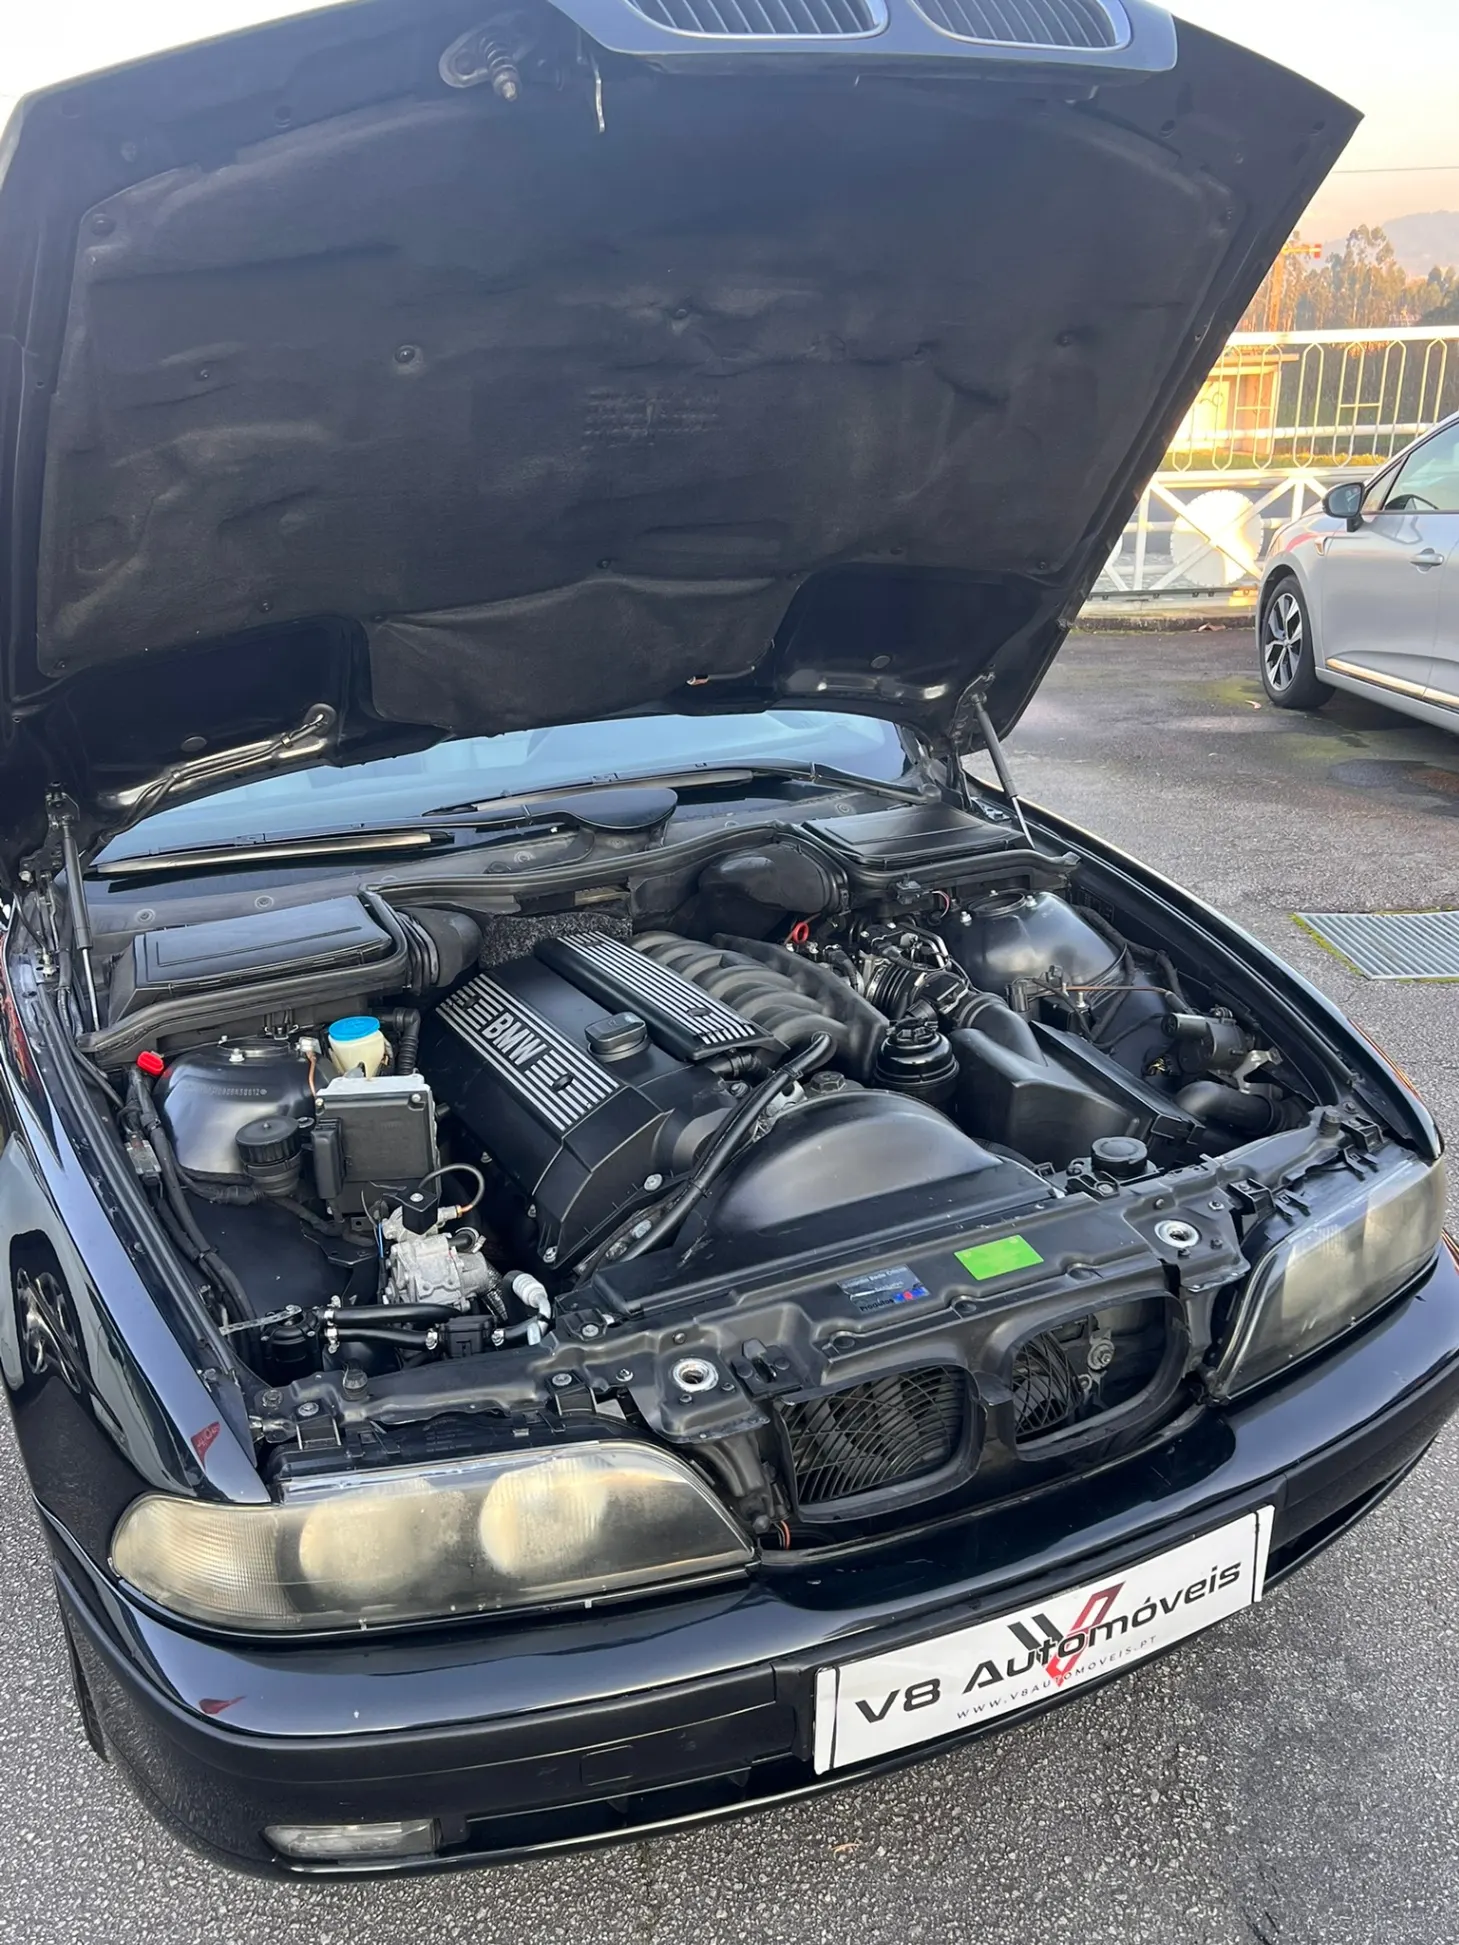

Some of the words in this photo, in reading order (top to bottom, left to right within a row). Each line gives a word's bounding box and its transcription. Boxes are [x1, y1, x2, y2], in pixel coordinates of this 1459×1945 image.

[482, 1012, 548, 1066] BMW
[855, 1678, 941, 1724] V8
[962, 1562, 1242, 1695] Automóveis
